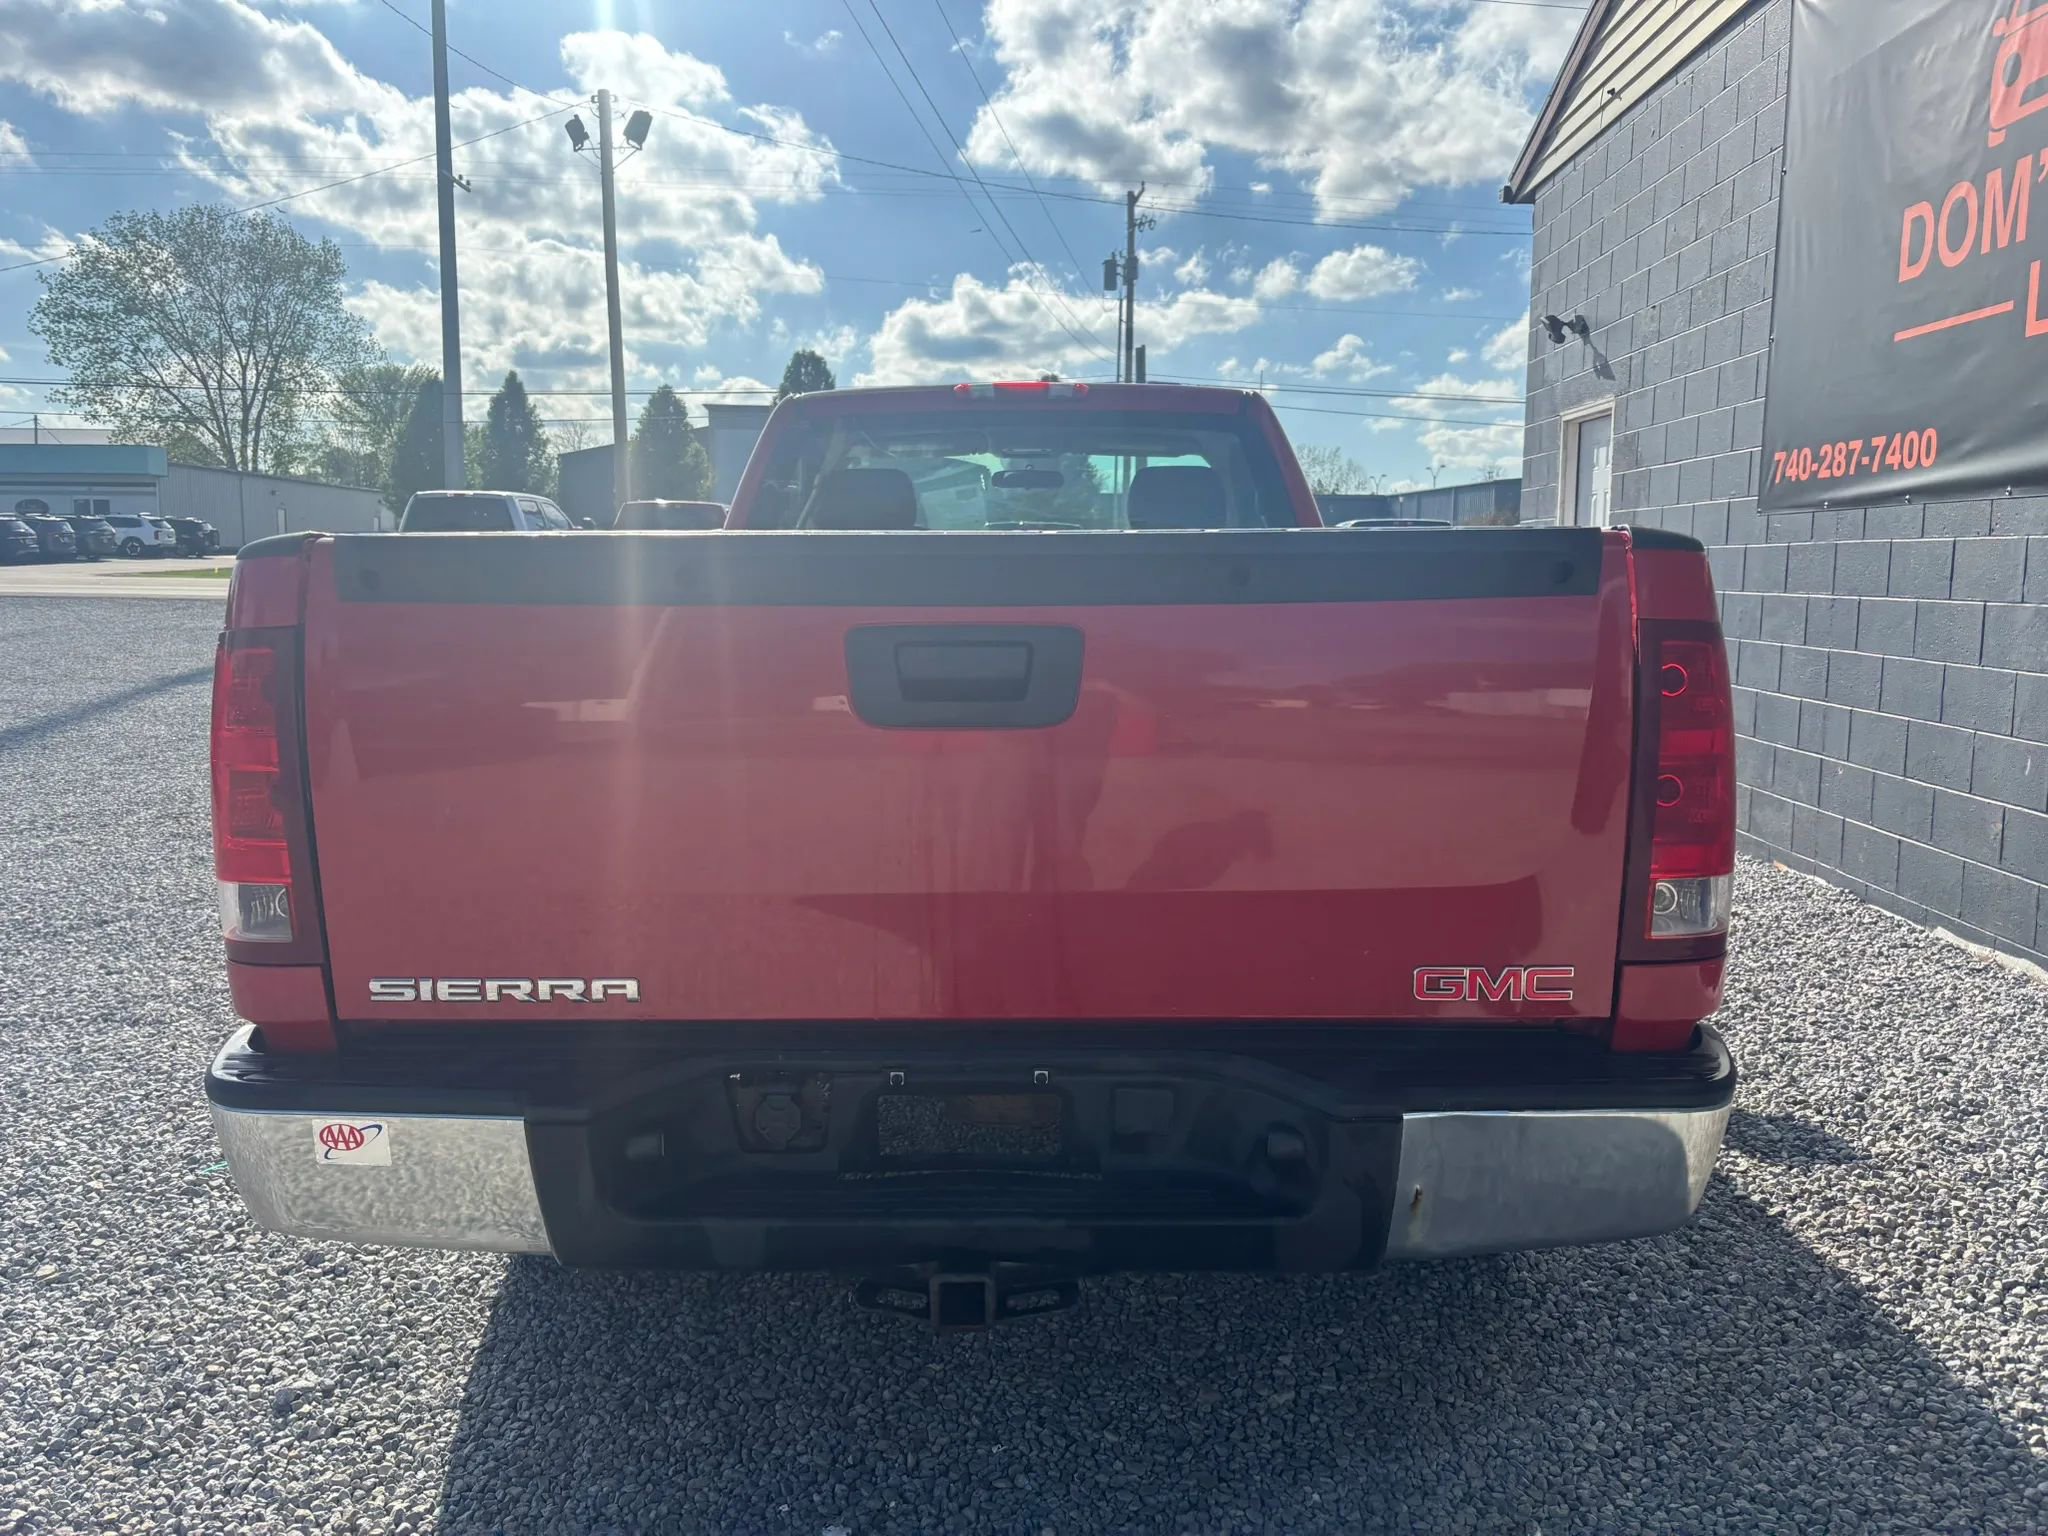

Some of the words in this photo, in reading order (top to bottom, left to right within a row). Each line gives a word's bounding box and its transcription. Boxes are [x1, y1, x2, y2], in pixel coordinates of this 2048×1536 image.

[1774, 428, 1938, 484] 740-287-7400
[368, 977, 641, 1002] SIERRA
[1413, 966, 1576, 1002] GMC
[324, 1125, 362, 1150] AAA
